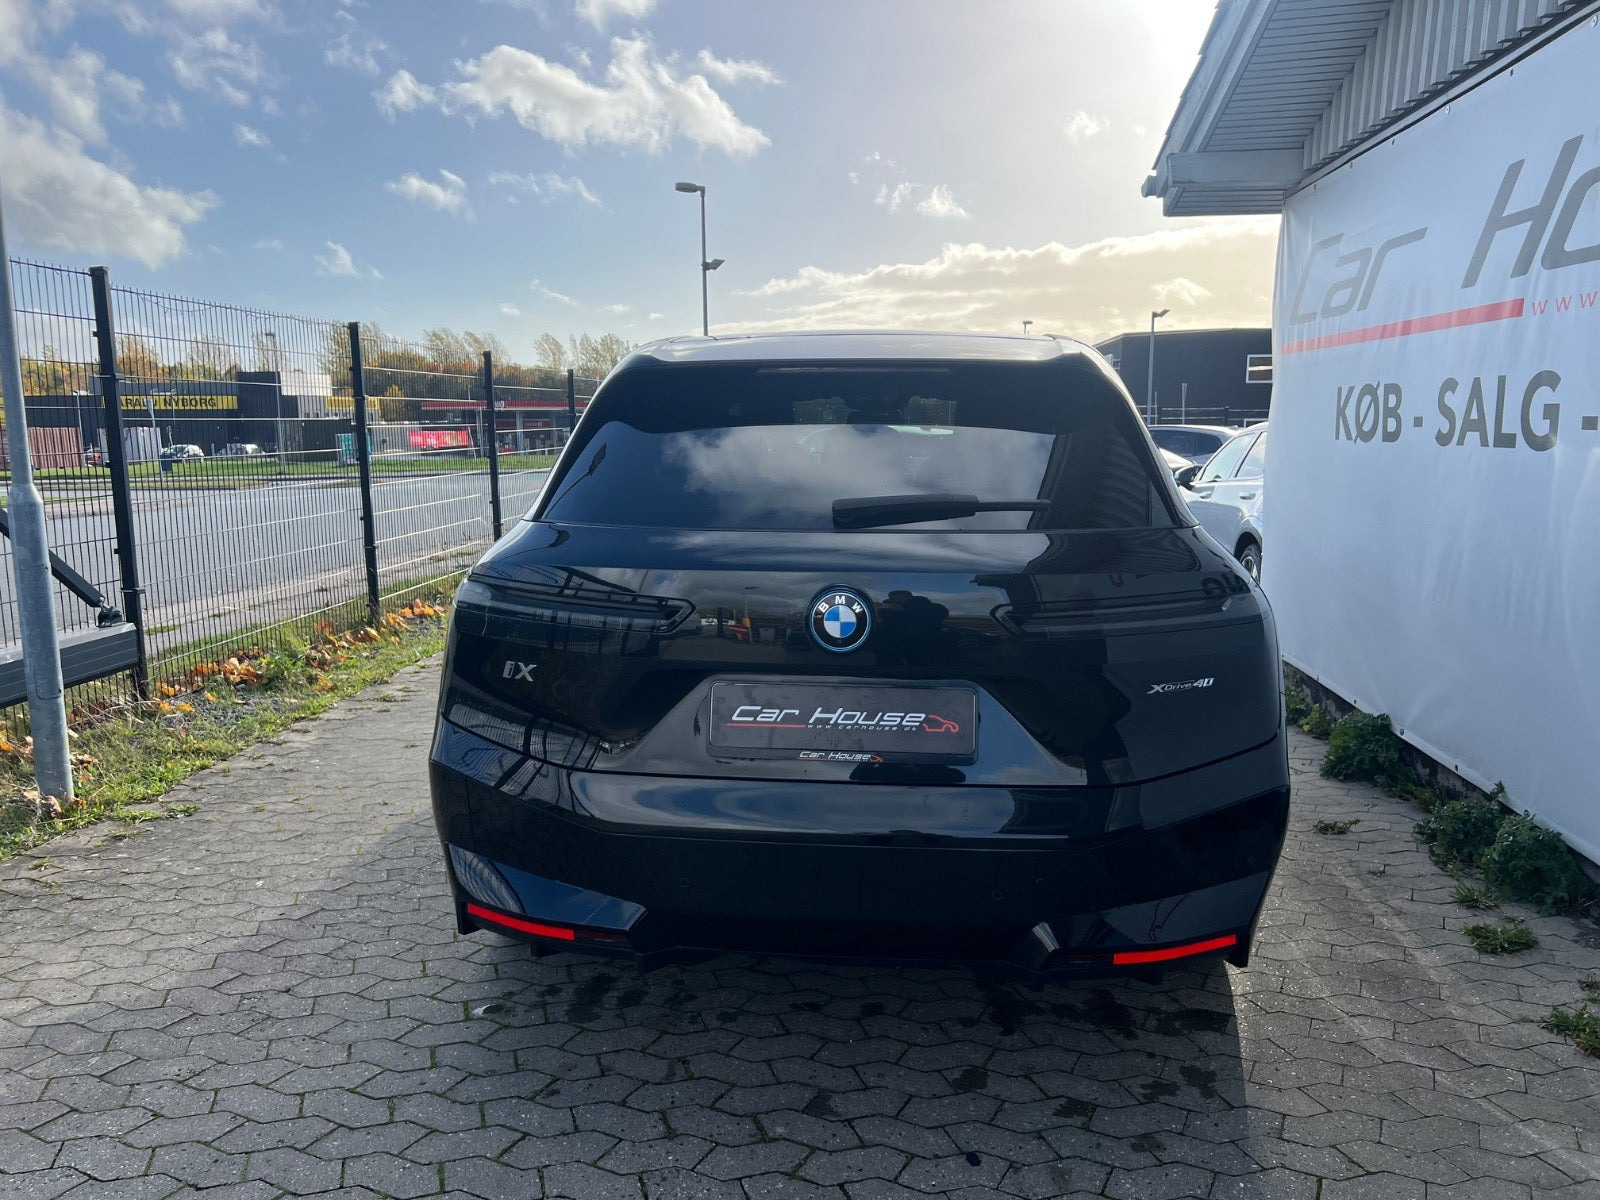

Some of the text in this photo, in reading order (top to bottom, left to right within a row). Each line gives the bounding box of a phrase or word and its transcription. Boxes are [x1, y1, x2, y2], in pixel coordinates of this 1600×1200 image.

[1290, 226, 1429, 326] Car
[163, 397, 218, 408] NYBORG
[1334, 380, 1403, 444] KØB
[1435, 369, 1562, 452] SALG
[818, 595, 863, 613] BMW
[731, 705, 926, 727] Car House
[827, 751, 871, 760] House
